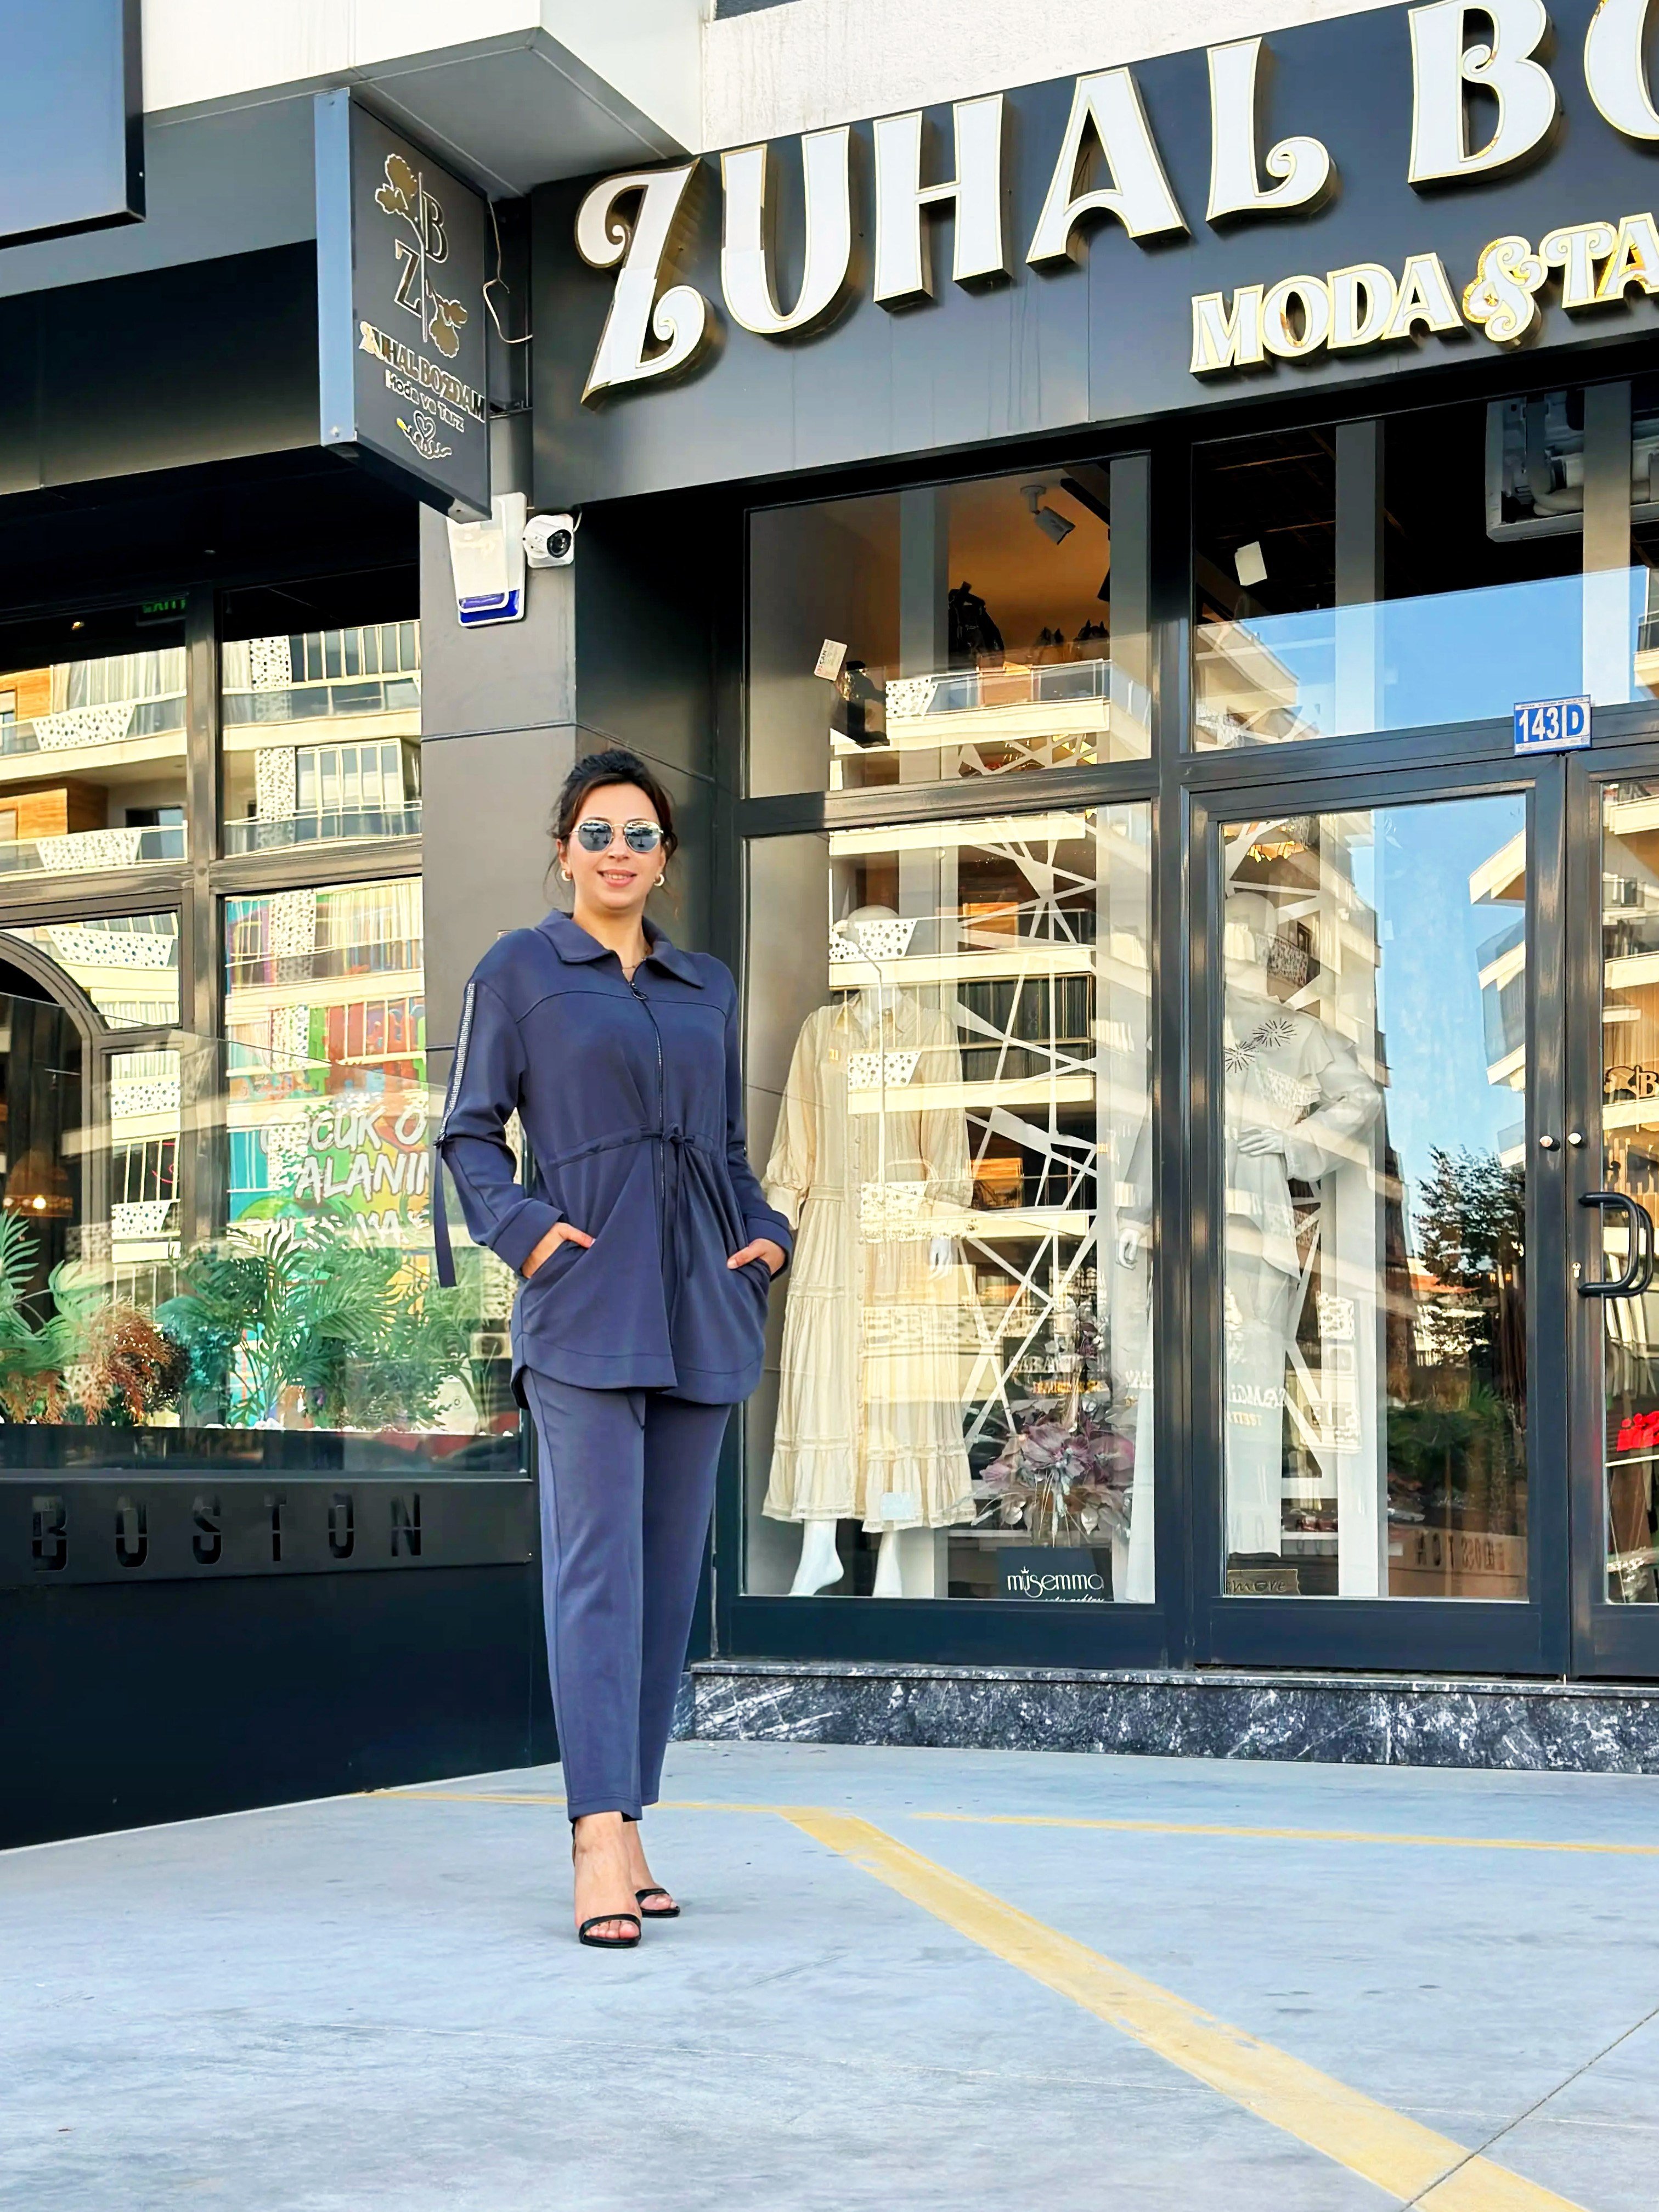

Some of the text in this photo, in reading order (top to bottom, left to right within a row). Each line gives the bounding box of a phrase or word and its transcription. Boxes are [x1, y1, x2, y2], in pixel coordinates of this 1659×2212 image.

[421, 190, 448, 263] B
[575, 37, 1335, 409] ZUHAL
[394, 238, 422, 318] Z
[32, 1493, 421, 1571] BOSTON
